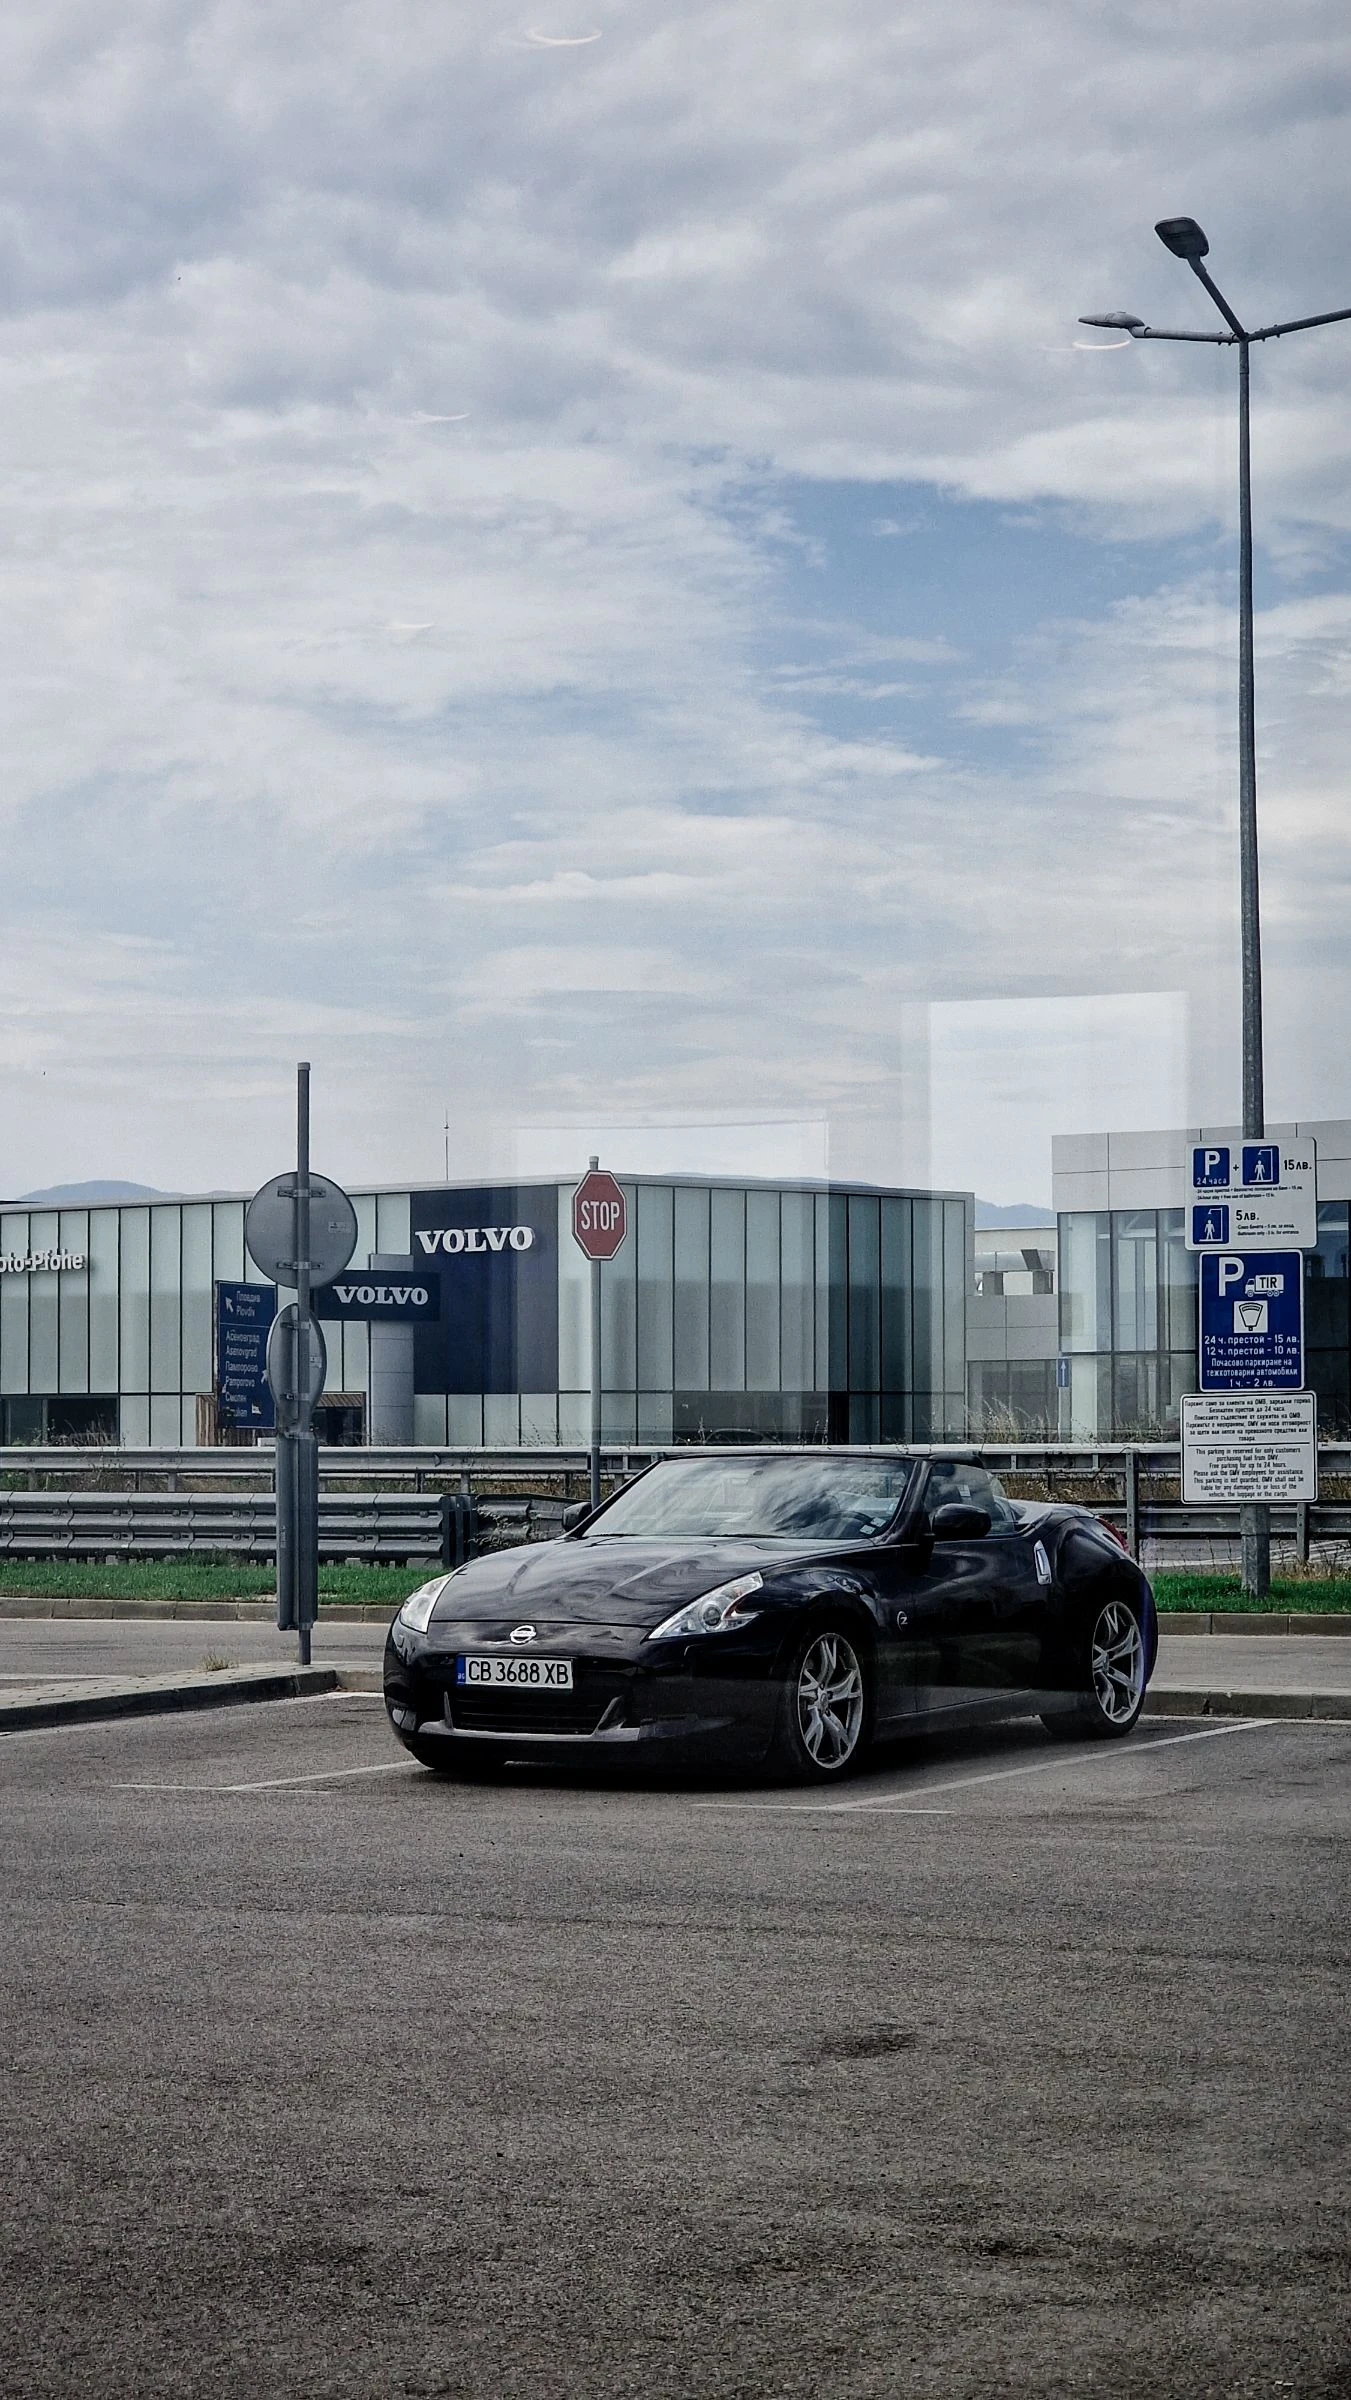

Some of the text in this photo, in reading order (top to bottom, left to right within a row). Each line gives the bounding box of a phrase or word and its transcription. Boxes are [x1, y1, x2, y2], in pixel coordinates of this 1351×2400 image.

[1205, 1151, 1220, 1176] P
[1209, 1177, 1227, 1185] часа
[581, 1200, 620, 1231] STOP
[415, 1226, 535, 1254] VOLVO
[1219, 1257, 1245, 1297] P
[1259, 1277, 1278, 1289] TIR
[333, 1285, 429, 1306] VOLVO
[236, 1306, 256, 1317] Plovdiv
[1204, 1336, 1216, 1344] 24
[1228, 1336, 1265, 1346] престой
[1274, 1334, 1284, 1343] 15
[226, 1345, 258, 1359] Asenovgrad
[1207, 1347, 1216, 1356] 12
[1228, 1348, 1265, 1357] престой
[1274, 1346, 1284, 1354] 10
[1211, 1358, 1244, 1367] Почасово
[1245, 1359, 1282, 1368] паркиране
[1207, 1367, 1298, 1378] тежкотоварни автомобили
[1230, 1379, 1233, 1388] 1
[1254, 1378, 1260, 1387] 2
[1263, 1447, 1274, 1455] only
[469, 1661, 569, 1685] CB 3688 XB
